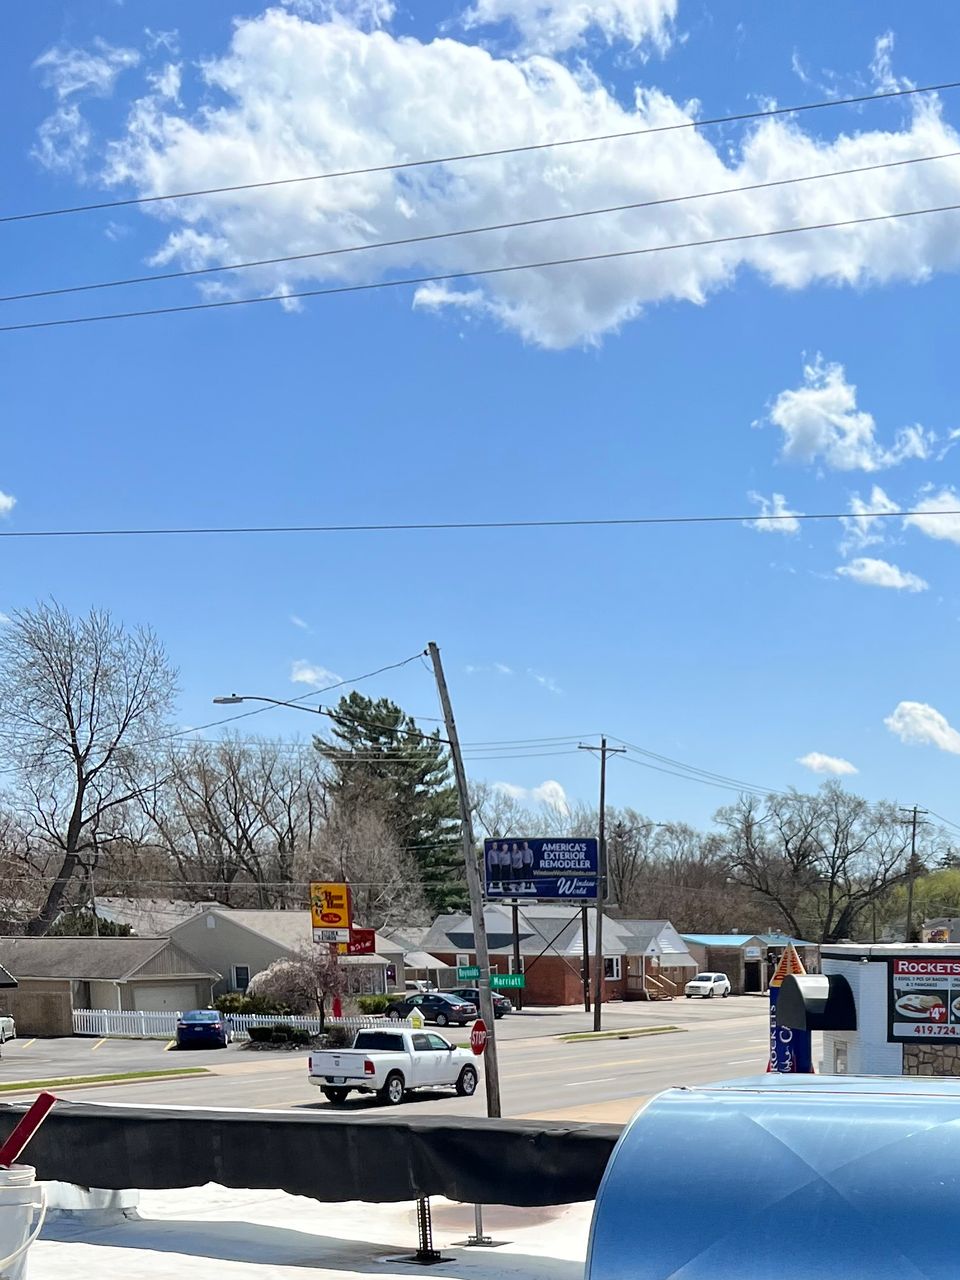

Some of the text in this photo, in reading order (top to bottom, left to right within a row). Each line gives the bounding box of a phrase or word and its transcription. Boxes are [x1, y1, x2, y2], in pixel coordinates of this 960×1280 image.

[541, 843, 587, 851] AMERICA'S
[544, 851, 585, 860] EXTERIOR
[539, 860, 591, 868] REMODELER
[898, 961, 960, 973] ROCKETS
[458, 968, 479, 978] Reynolds
[472, 1031, 486, 1045] STOP
